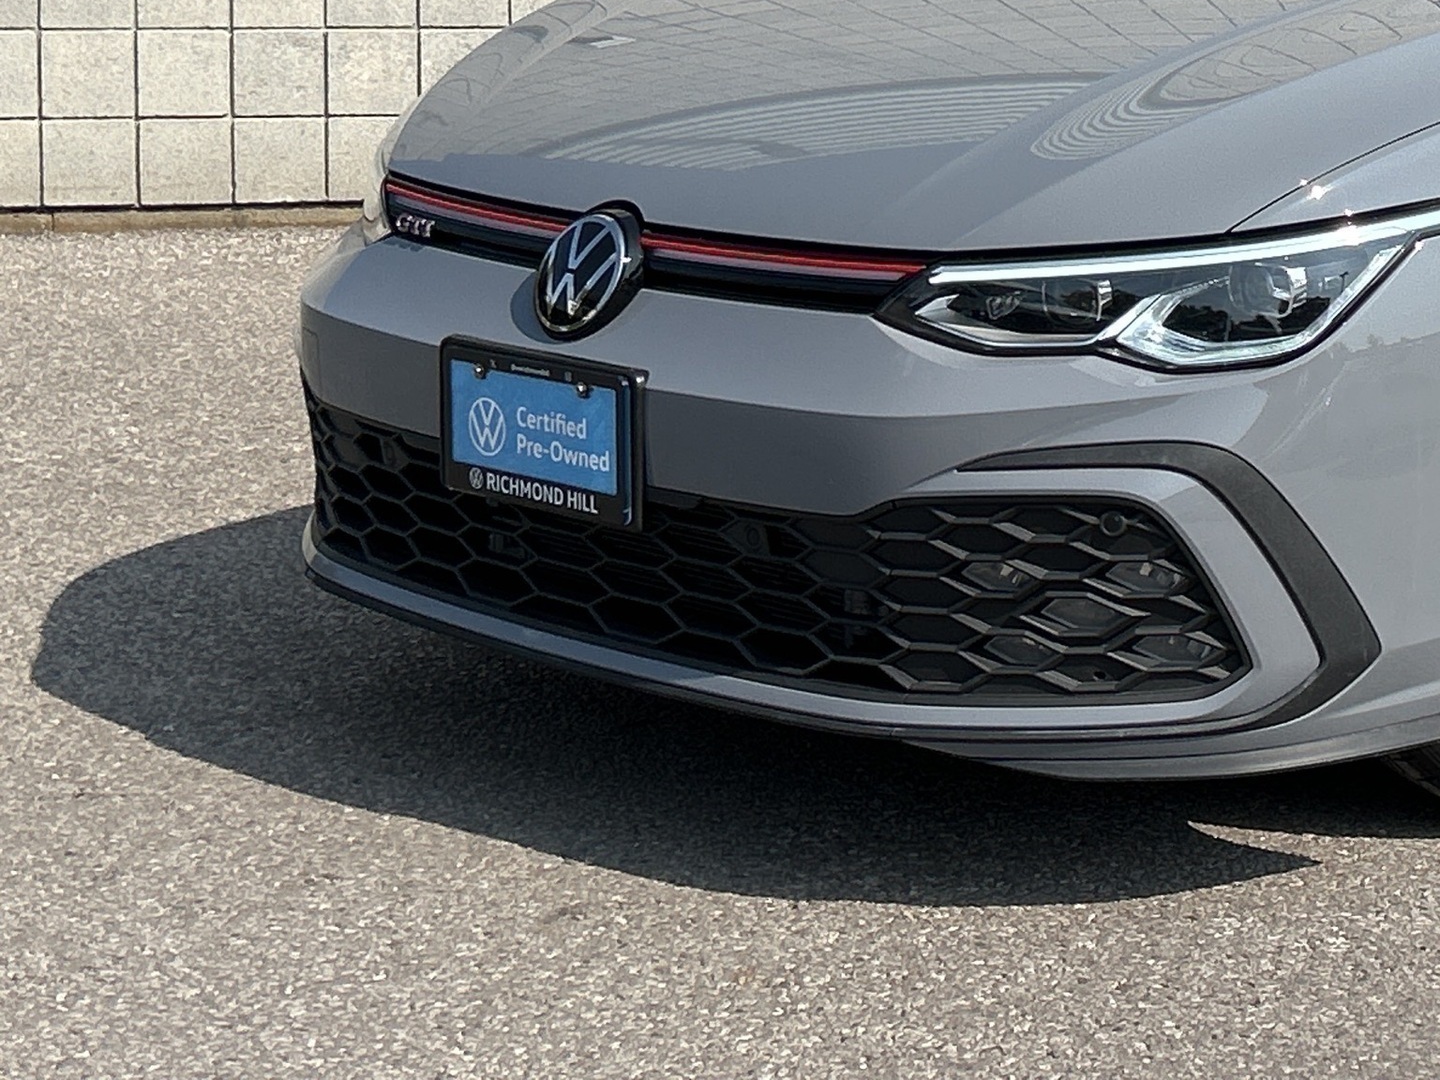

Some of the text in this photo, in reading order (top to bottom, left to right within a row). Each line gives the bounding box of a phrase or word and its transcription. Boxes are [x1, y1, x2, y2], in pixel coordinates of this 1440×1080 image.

[395, 212, 435, 238] GTI
[516, 406, 587, 440] Certified
[516, 433, 610, 472] Pre-Owned
[486, 471, 599, 515] RICHMOND HILL
